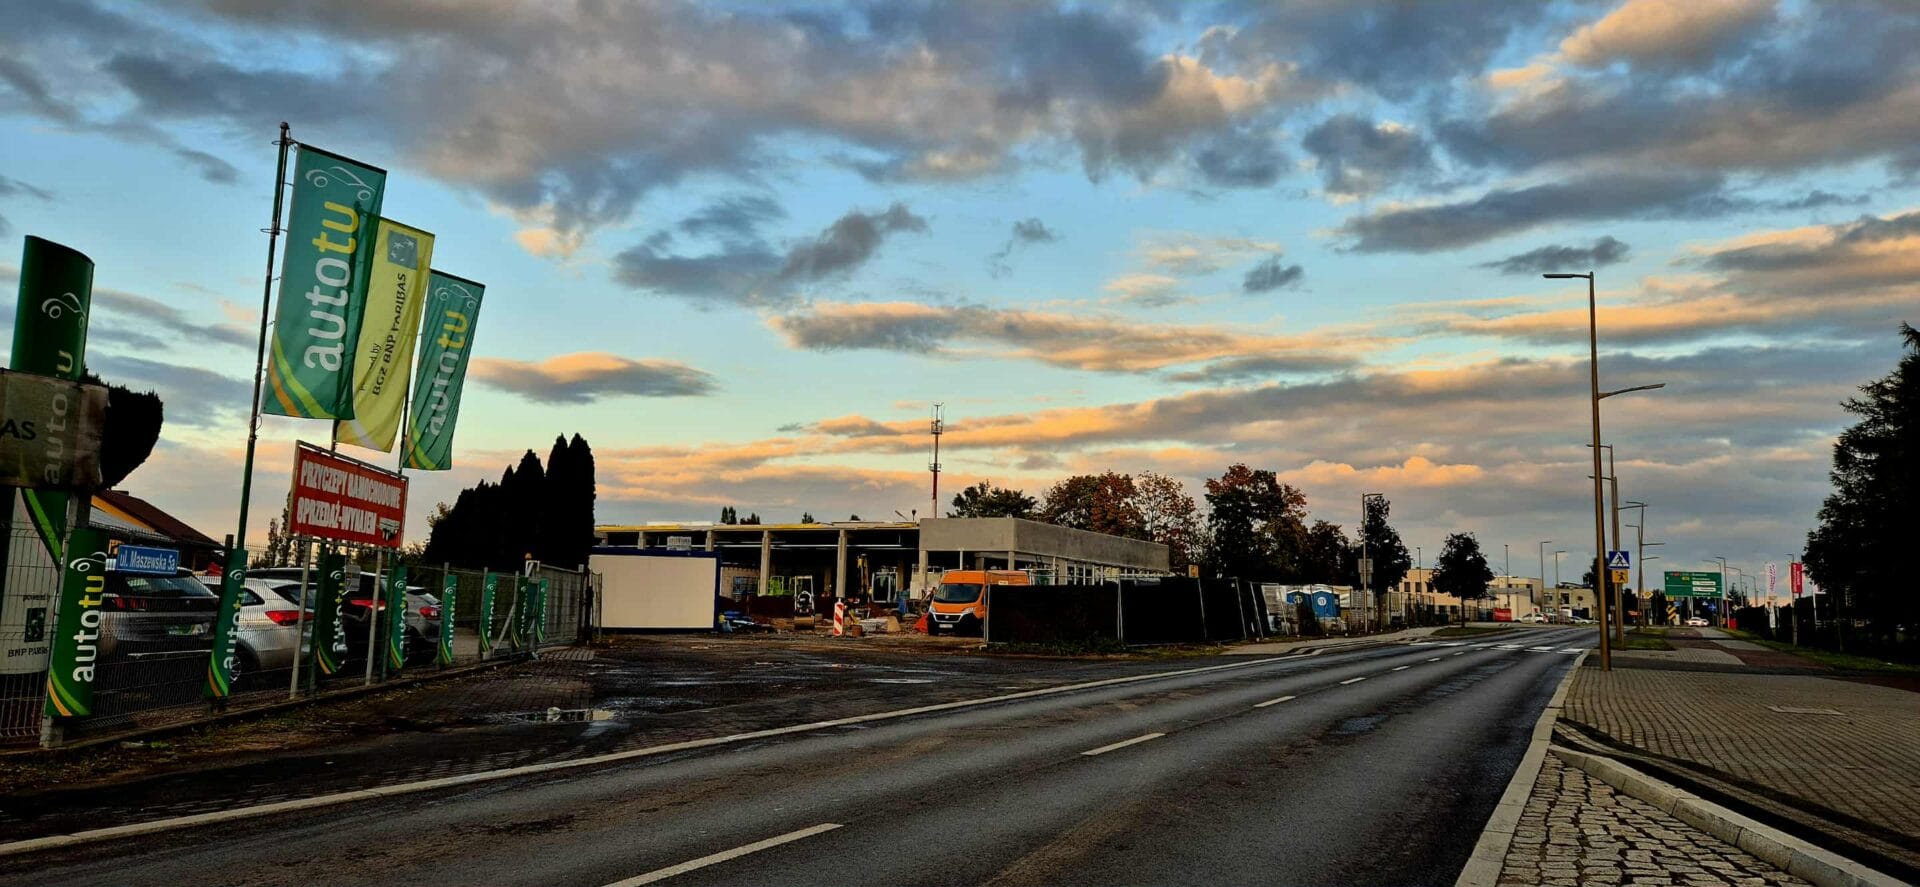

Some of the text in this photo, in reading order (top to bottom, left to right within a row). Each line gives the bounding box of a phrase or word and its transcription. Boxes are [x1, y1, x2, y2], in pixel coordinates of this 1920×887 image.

[303, 200, 360, 372] autotu
[383, 335, 397, 364] BNP
[391, 273, 407, 333] PARIBAS
[300, 459, 402, 509] PRZYCZEPY SAMOCHODOWE
[119, 550, 176, 571] ul. Maszewska 5a
[72, 575, 105, 683] autotu
